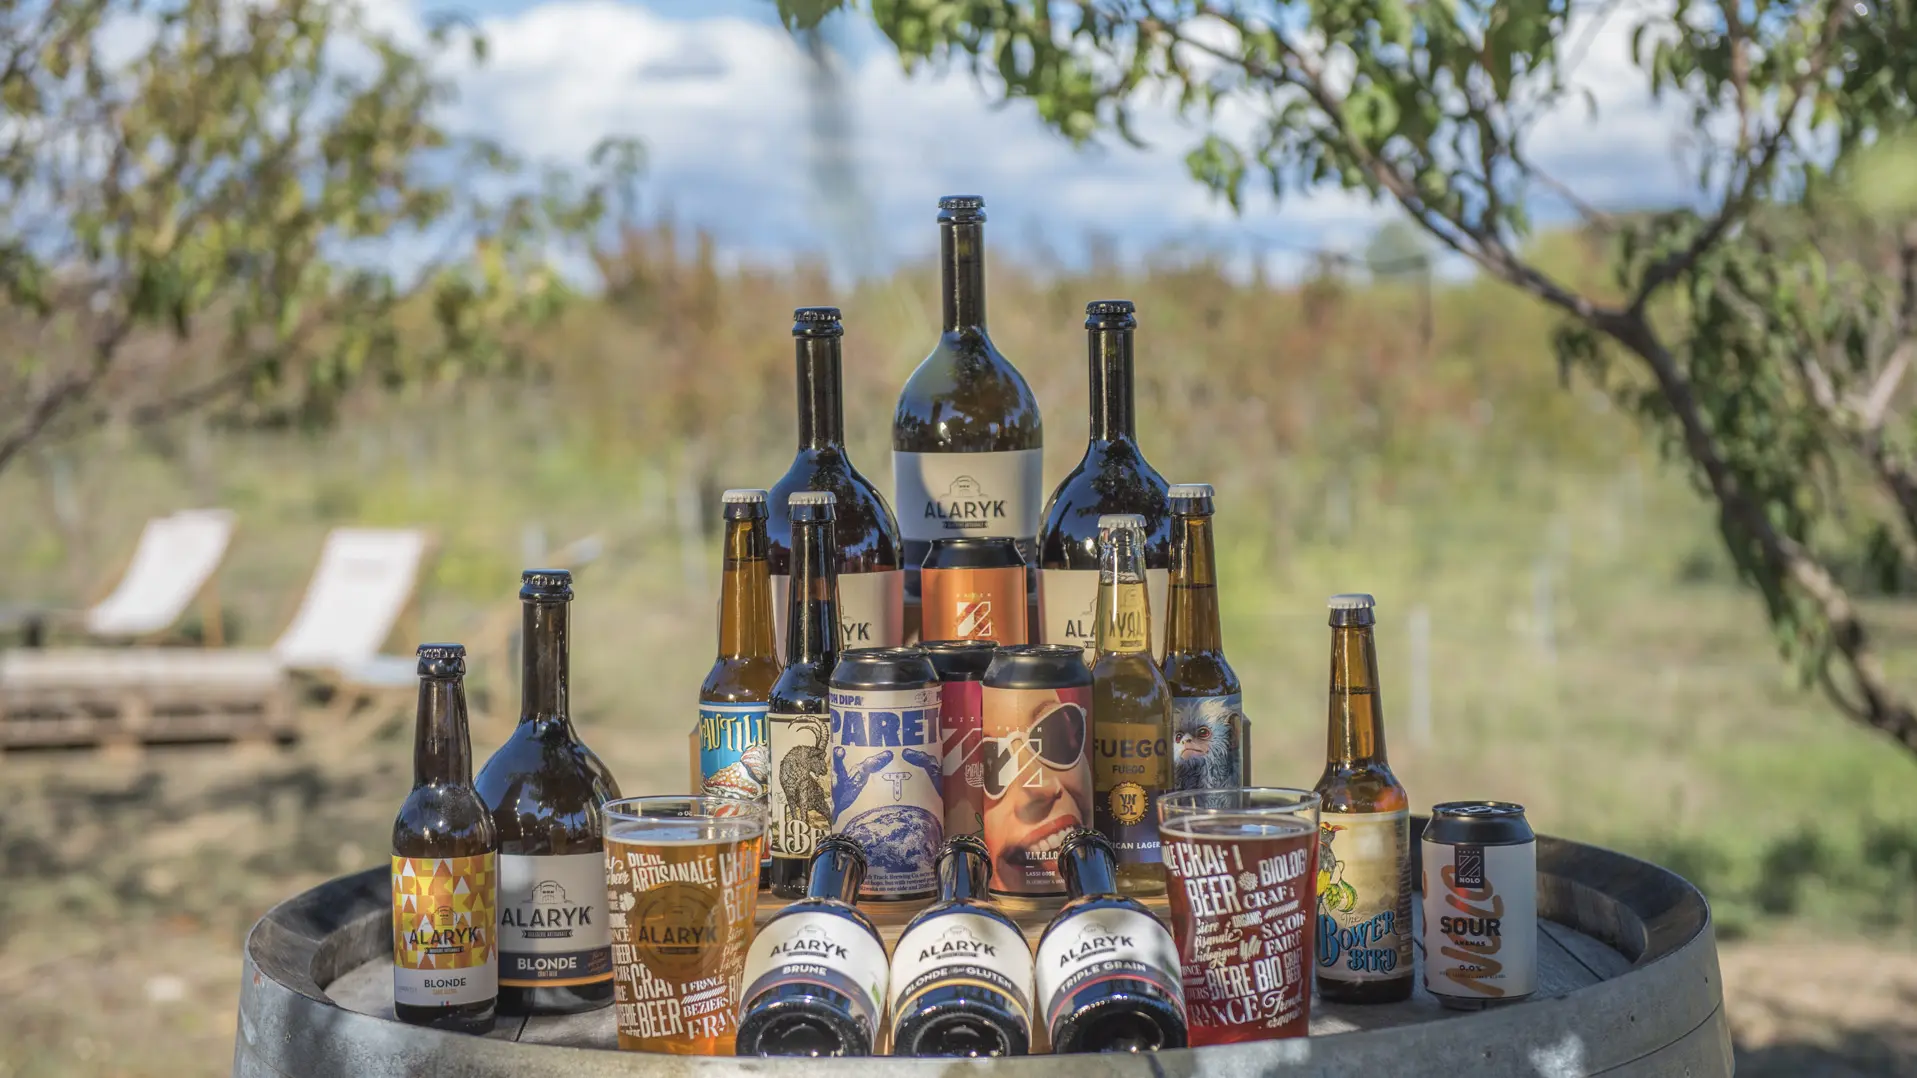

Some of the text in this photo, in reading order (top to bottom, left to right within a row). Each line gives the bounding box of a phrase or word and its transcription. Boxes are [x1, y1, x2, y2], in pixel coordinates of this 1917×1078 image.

[923, 500, 1007, 518] ALARYK
[700, 713, 769, 753] AUTILU
[829, 709, 943, 748] PARET
[1112, 764, 1145, 774] FUEGO
[1025, 851, 1059, 861] V.I.T.R.I.O
[1112, 840, 1161, 851] ICAN LAGER
[632, 855, 718, 892] ARTISANALE
[1184, 874, 1243, 918] BEER
[501, 906, 592, 928] ALARYK
[1440, 916, 1502, 937] SOUR
[409, 926, 477, 946] ALARYK
[638, 925, 718, 945] ALARYK
[1264, 930, 1303, 957] FAIRE
[769, 939, 849, 961] ALARYK
[918, 940, 997, 962] ALARYK
[1059, 935, 1135, 968] ALARYK
[516, 956, 578, 971] BLONDE
[782, 964, 828, 976] BRUNE
[1347, 948, 1398, 975] BIRD
[424, 977, 467, 988] BLONDE
[905, 967, 949, 996] BLONDE
[965, 966, 1012, 990] GLUTEN
[1060, 961, 1147, 993] TRIPLE GRAIN
[1252, 955, 1284, 993] BIO
[636, 998, 685, 1039] BEER
